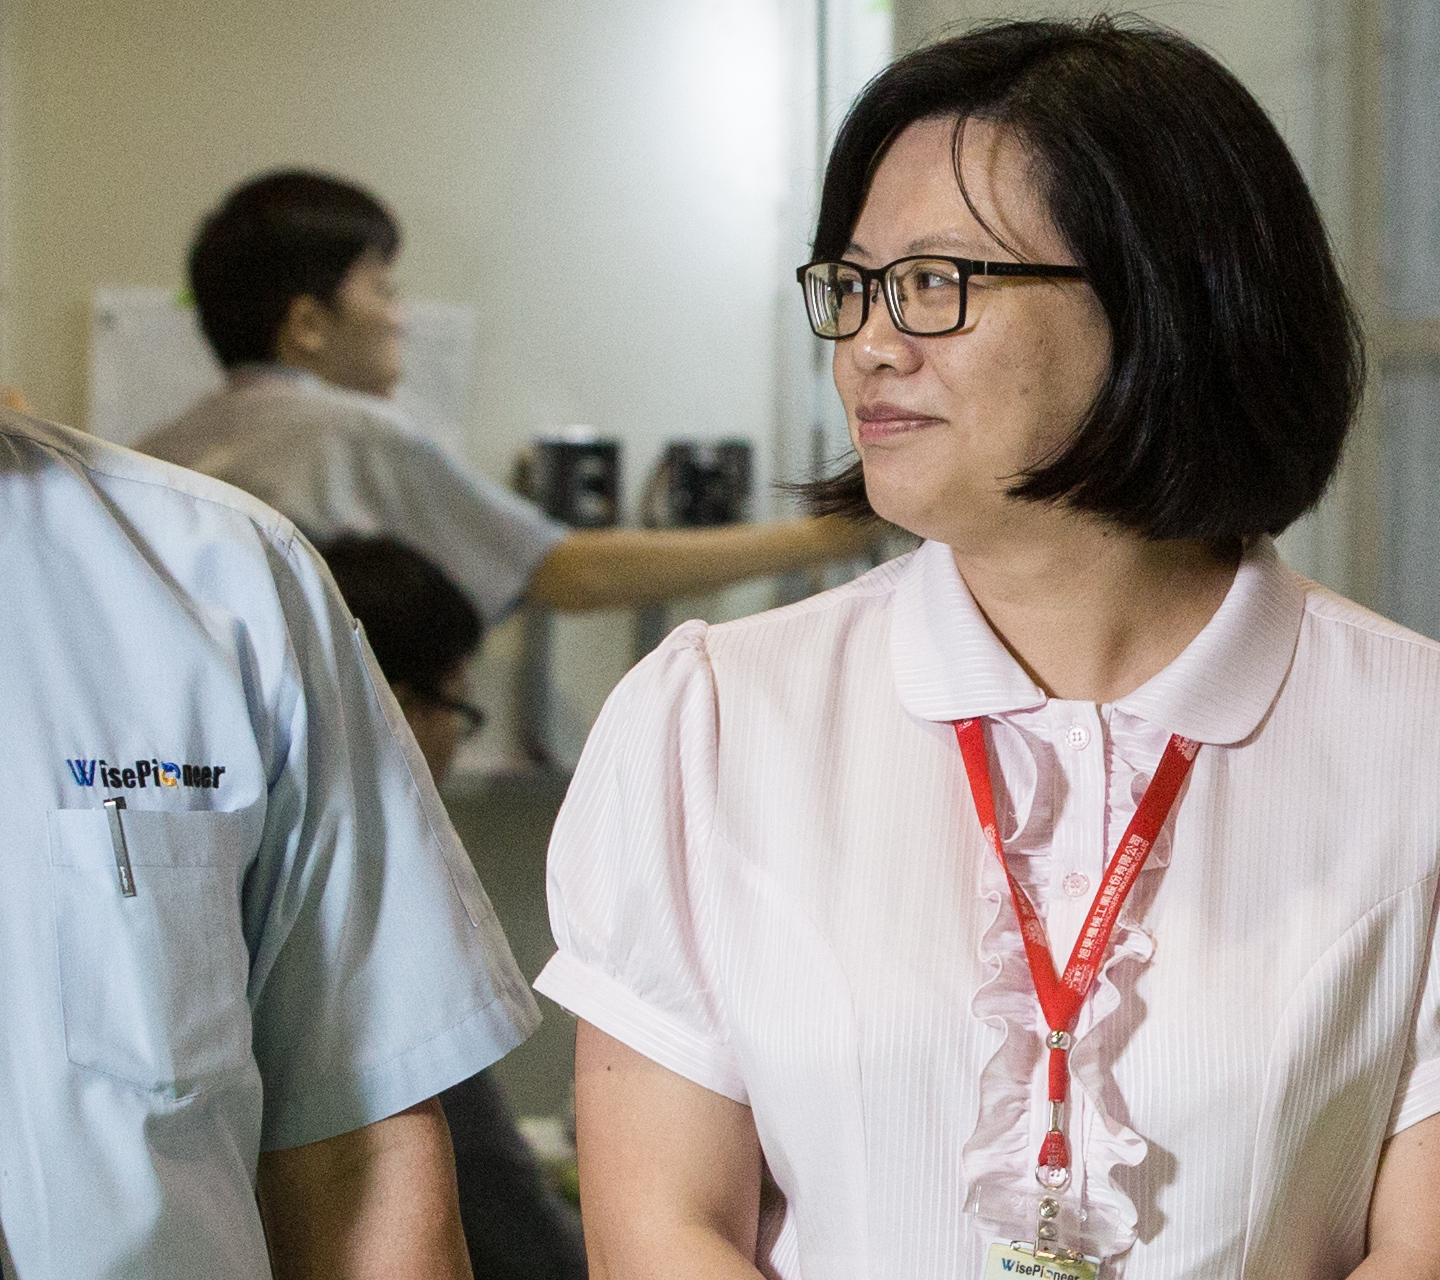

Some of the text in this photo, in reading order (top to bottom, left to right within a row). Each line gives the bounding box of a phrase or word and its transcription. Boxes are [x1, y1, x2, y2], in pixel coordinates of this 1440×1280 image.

[1078, 833, 1145, 960] 旭東機械工業股份有限公司
